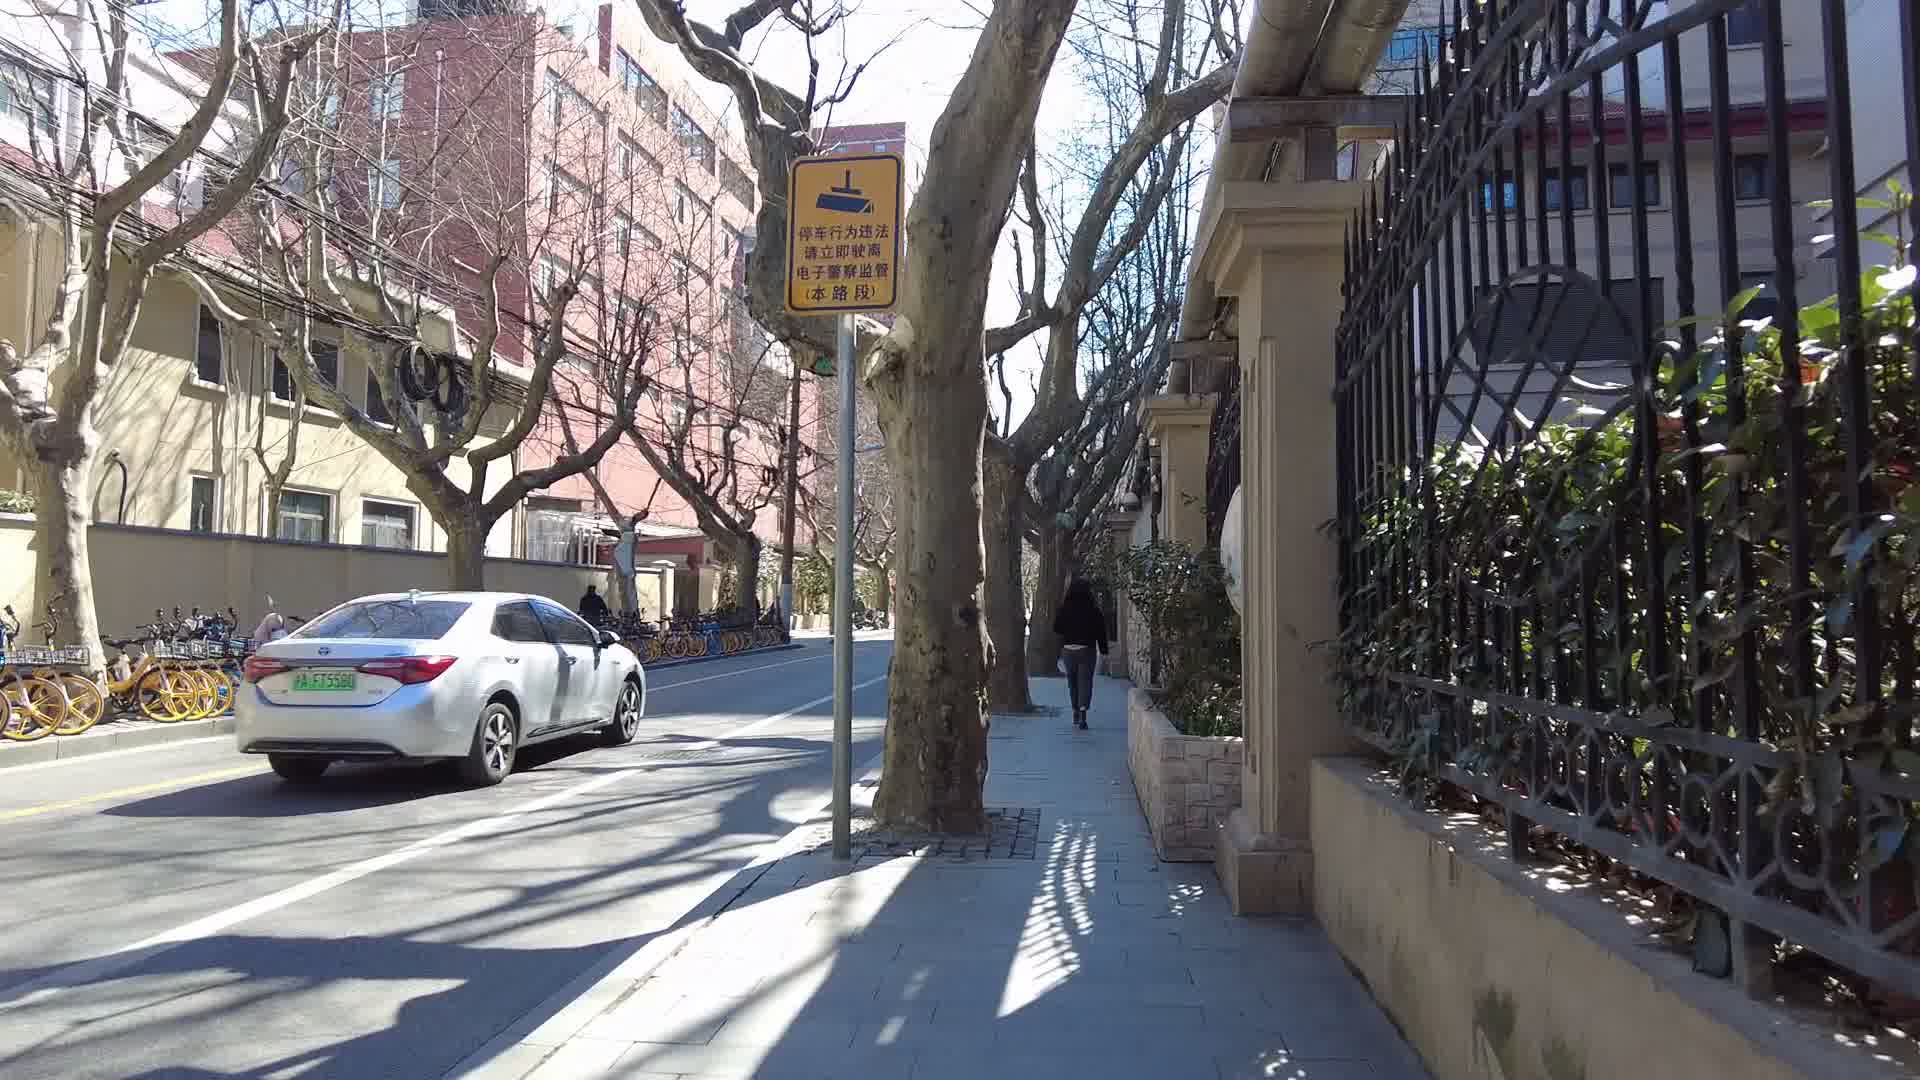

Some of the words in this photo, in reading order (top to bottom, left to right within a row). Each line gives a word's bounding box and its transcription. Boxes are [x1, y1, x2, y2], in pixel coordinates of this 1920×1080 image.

[799, 224, 889, 241] 停车行为违法
[804, 243, 881, 260] 请立即驶离
[797, 263, 889, 281] 电子警察监管
